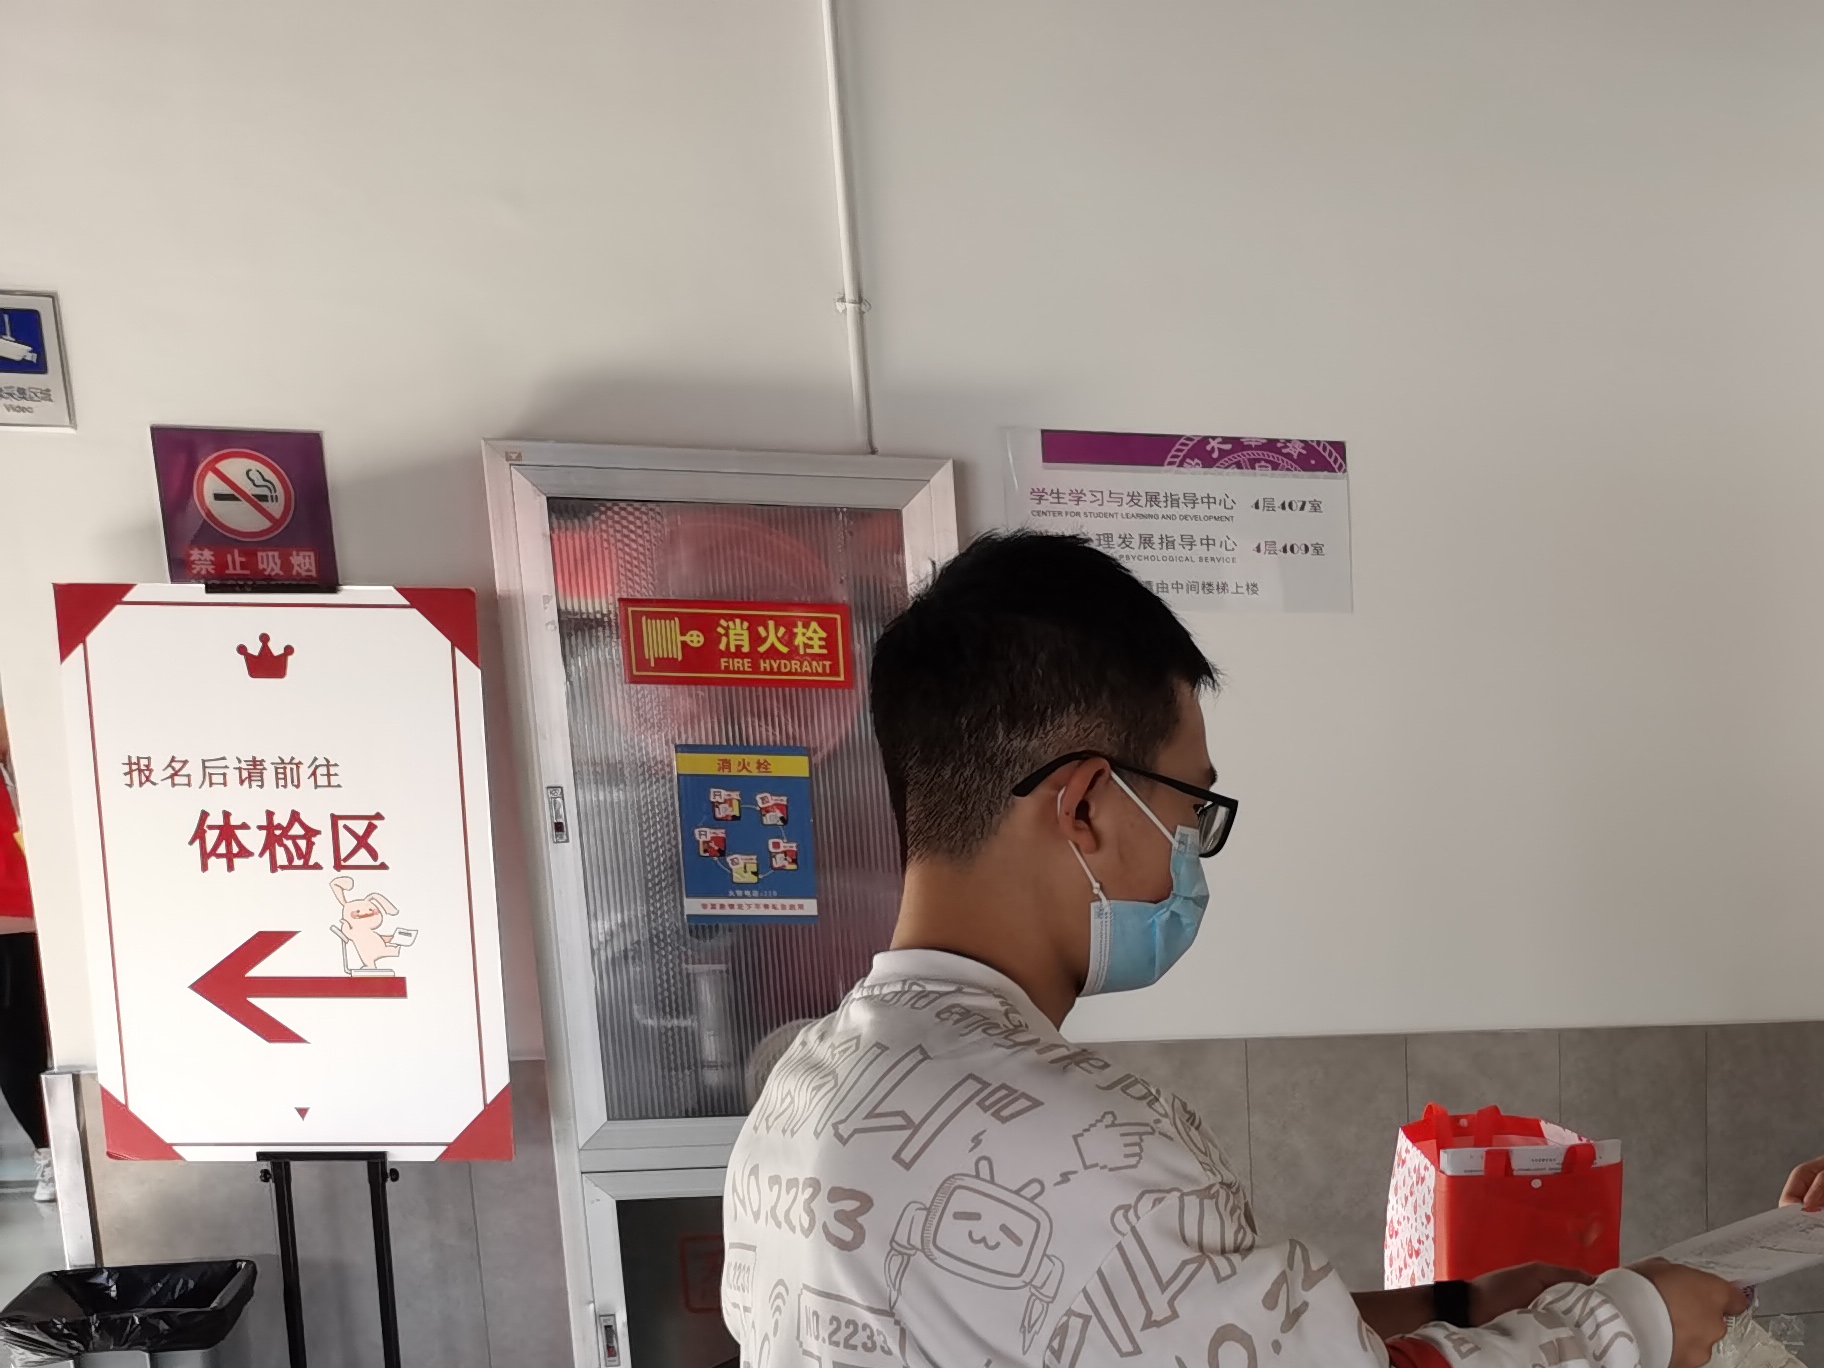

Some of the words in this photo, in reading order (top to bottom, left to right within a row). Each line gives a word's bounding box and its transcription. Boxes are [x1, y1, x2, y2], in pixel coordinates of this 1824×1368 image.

[1030, 487, 1237, 511] 学生学习与发展指导中心
[1251, 497, 1323, 513] 4层407室
[1031, 510, 1062, 518] CENTER
[1083, 512, 1118, 520] STUDENT
[1179, 514, 1235, 523] DEVELOPMENT
[1096, 533, 1238, 552] 理发展指导中心
[1252, 541, 1325, 556] 4层409室
[189, 548, 317, 577] 禁止吸烟
[1198, 556, 1236, 565] SERVICE
[716, 618, 828, 655] 消火栓
[720, 658, 752, 672] FIRE
[760, 658, 832, 674] HYDRANT
[122, 755, 343, 790] 报名后请前往
[716, 758, 773, 774] 消火栓
[188, 809, 390, 873] 体检区
[804, 1305, 894, 1356] NO.2233
